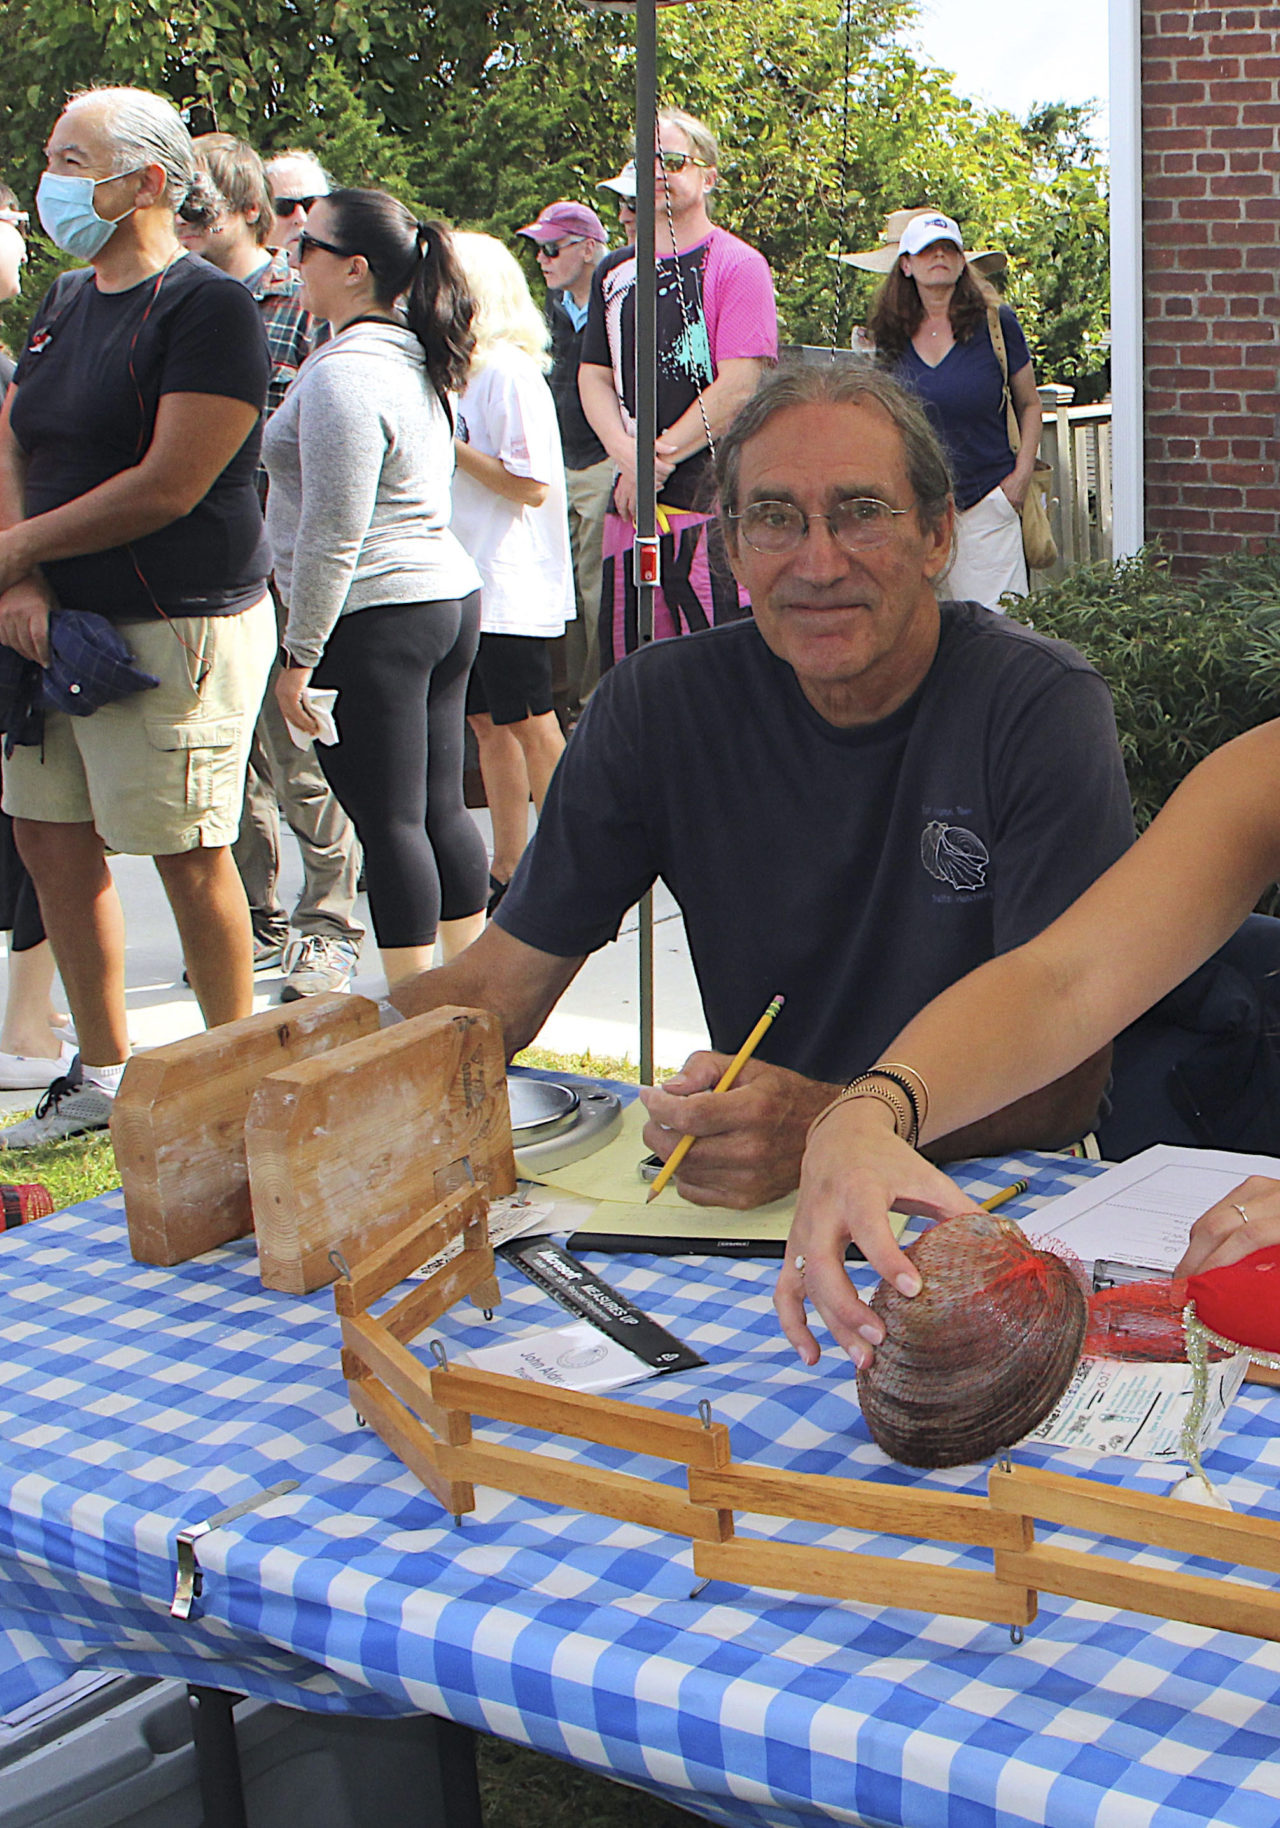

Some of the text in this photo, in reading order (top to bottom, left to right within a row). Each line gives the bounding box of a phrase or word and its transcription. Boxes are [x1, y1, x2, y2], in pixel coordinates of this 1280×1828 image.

[536, 1250, 639, 1325] Microsoft MEASURES UP
[520, 1352, 545, 1369] John
